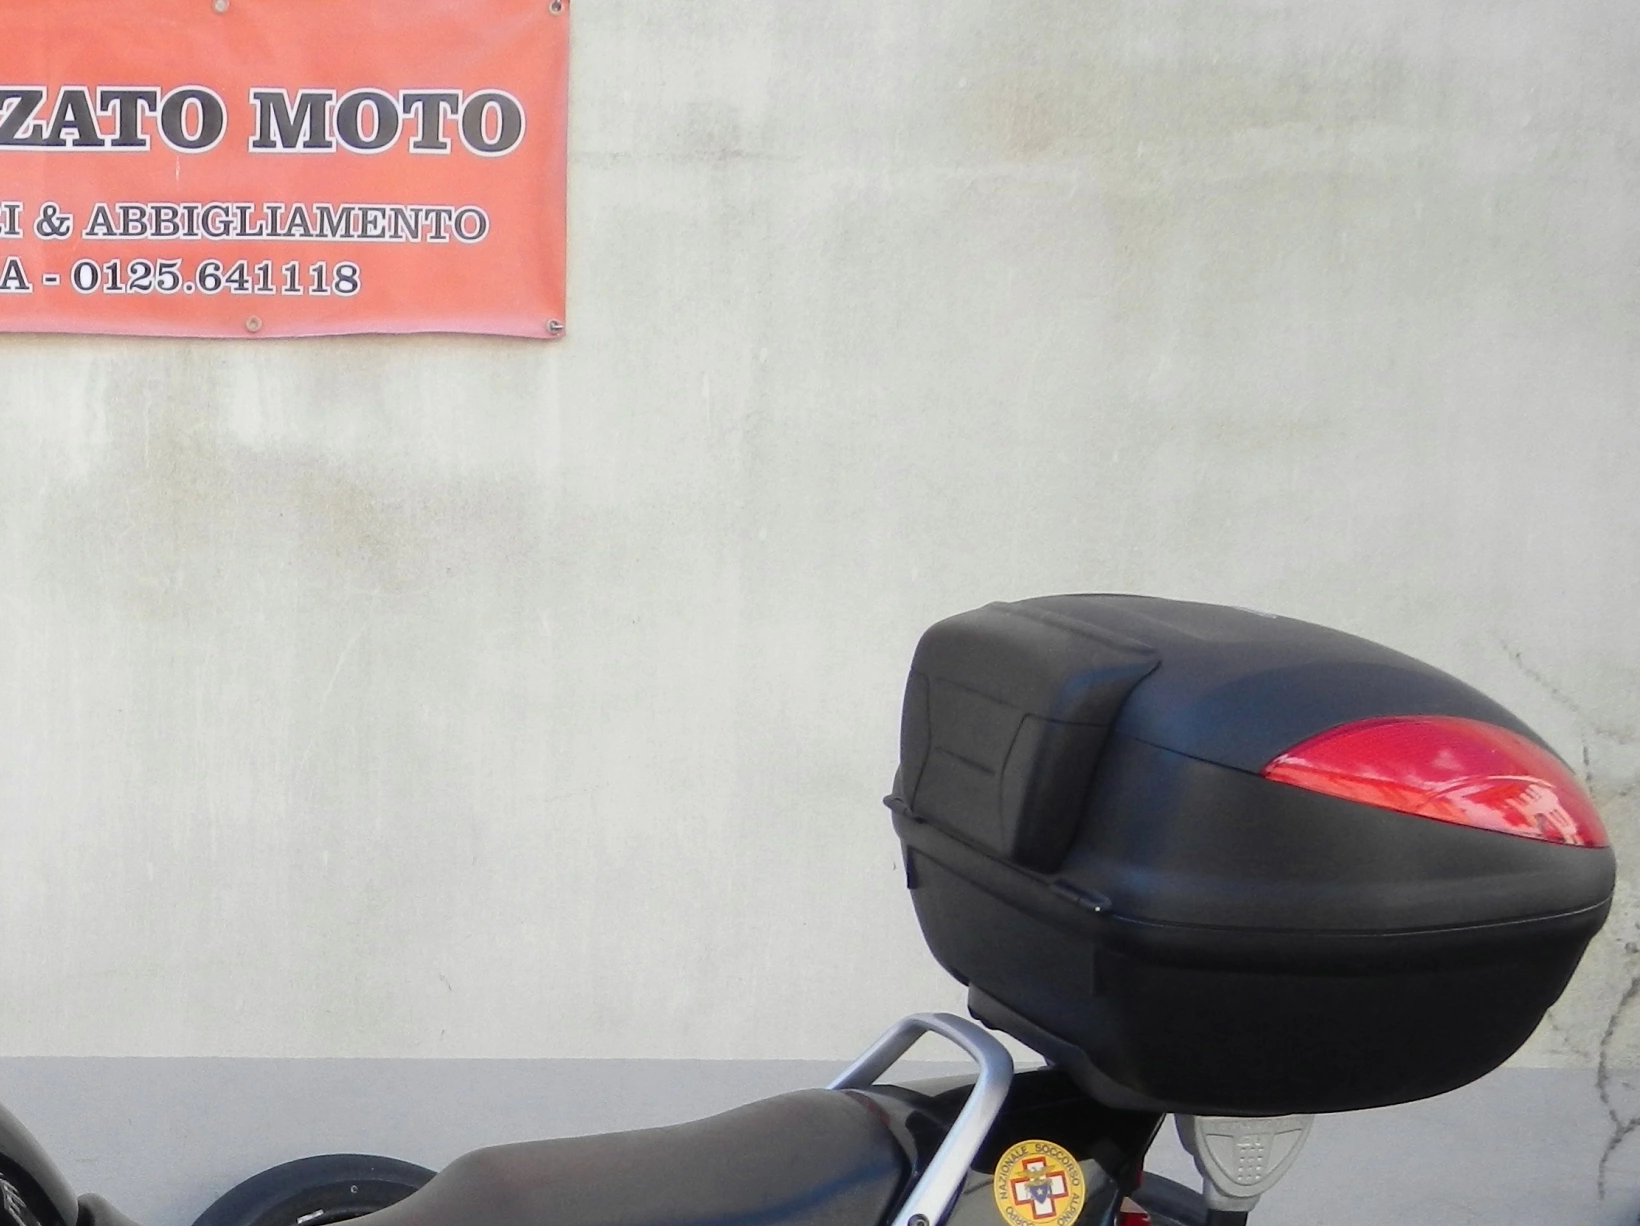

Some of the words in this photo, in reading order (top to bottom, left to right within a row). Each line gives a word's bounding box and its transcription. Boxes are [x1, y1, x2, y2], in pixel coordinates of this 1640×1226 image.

[249, 88, 525, 156] MOTO
[35, 203, 72, 238] &
[83, 203, 488, 242] ABBIGLIAMENTO
[71, 260, 360, 295] 0125.641118
[999, 1145, 1028, 1200] NAZIONALE
[1034, 1143, 1080, 1187] SOCCORSO
[1056, 1192, 1080, 1226] ALPINO
